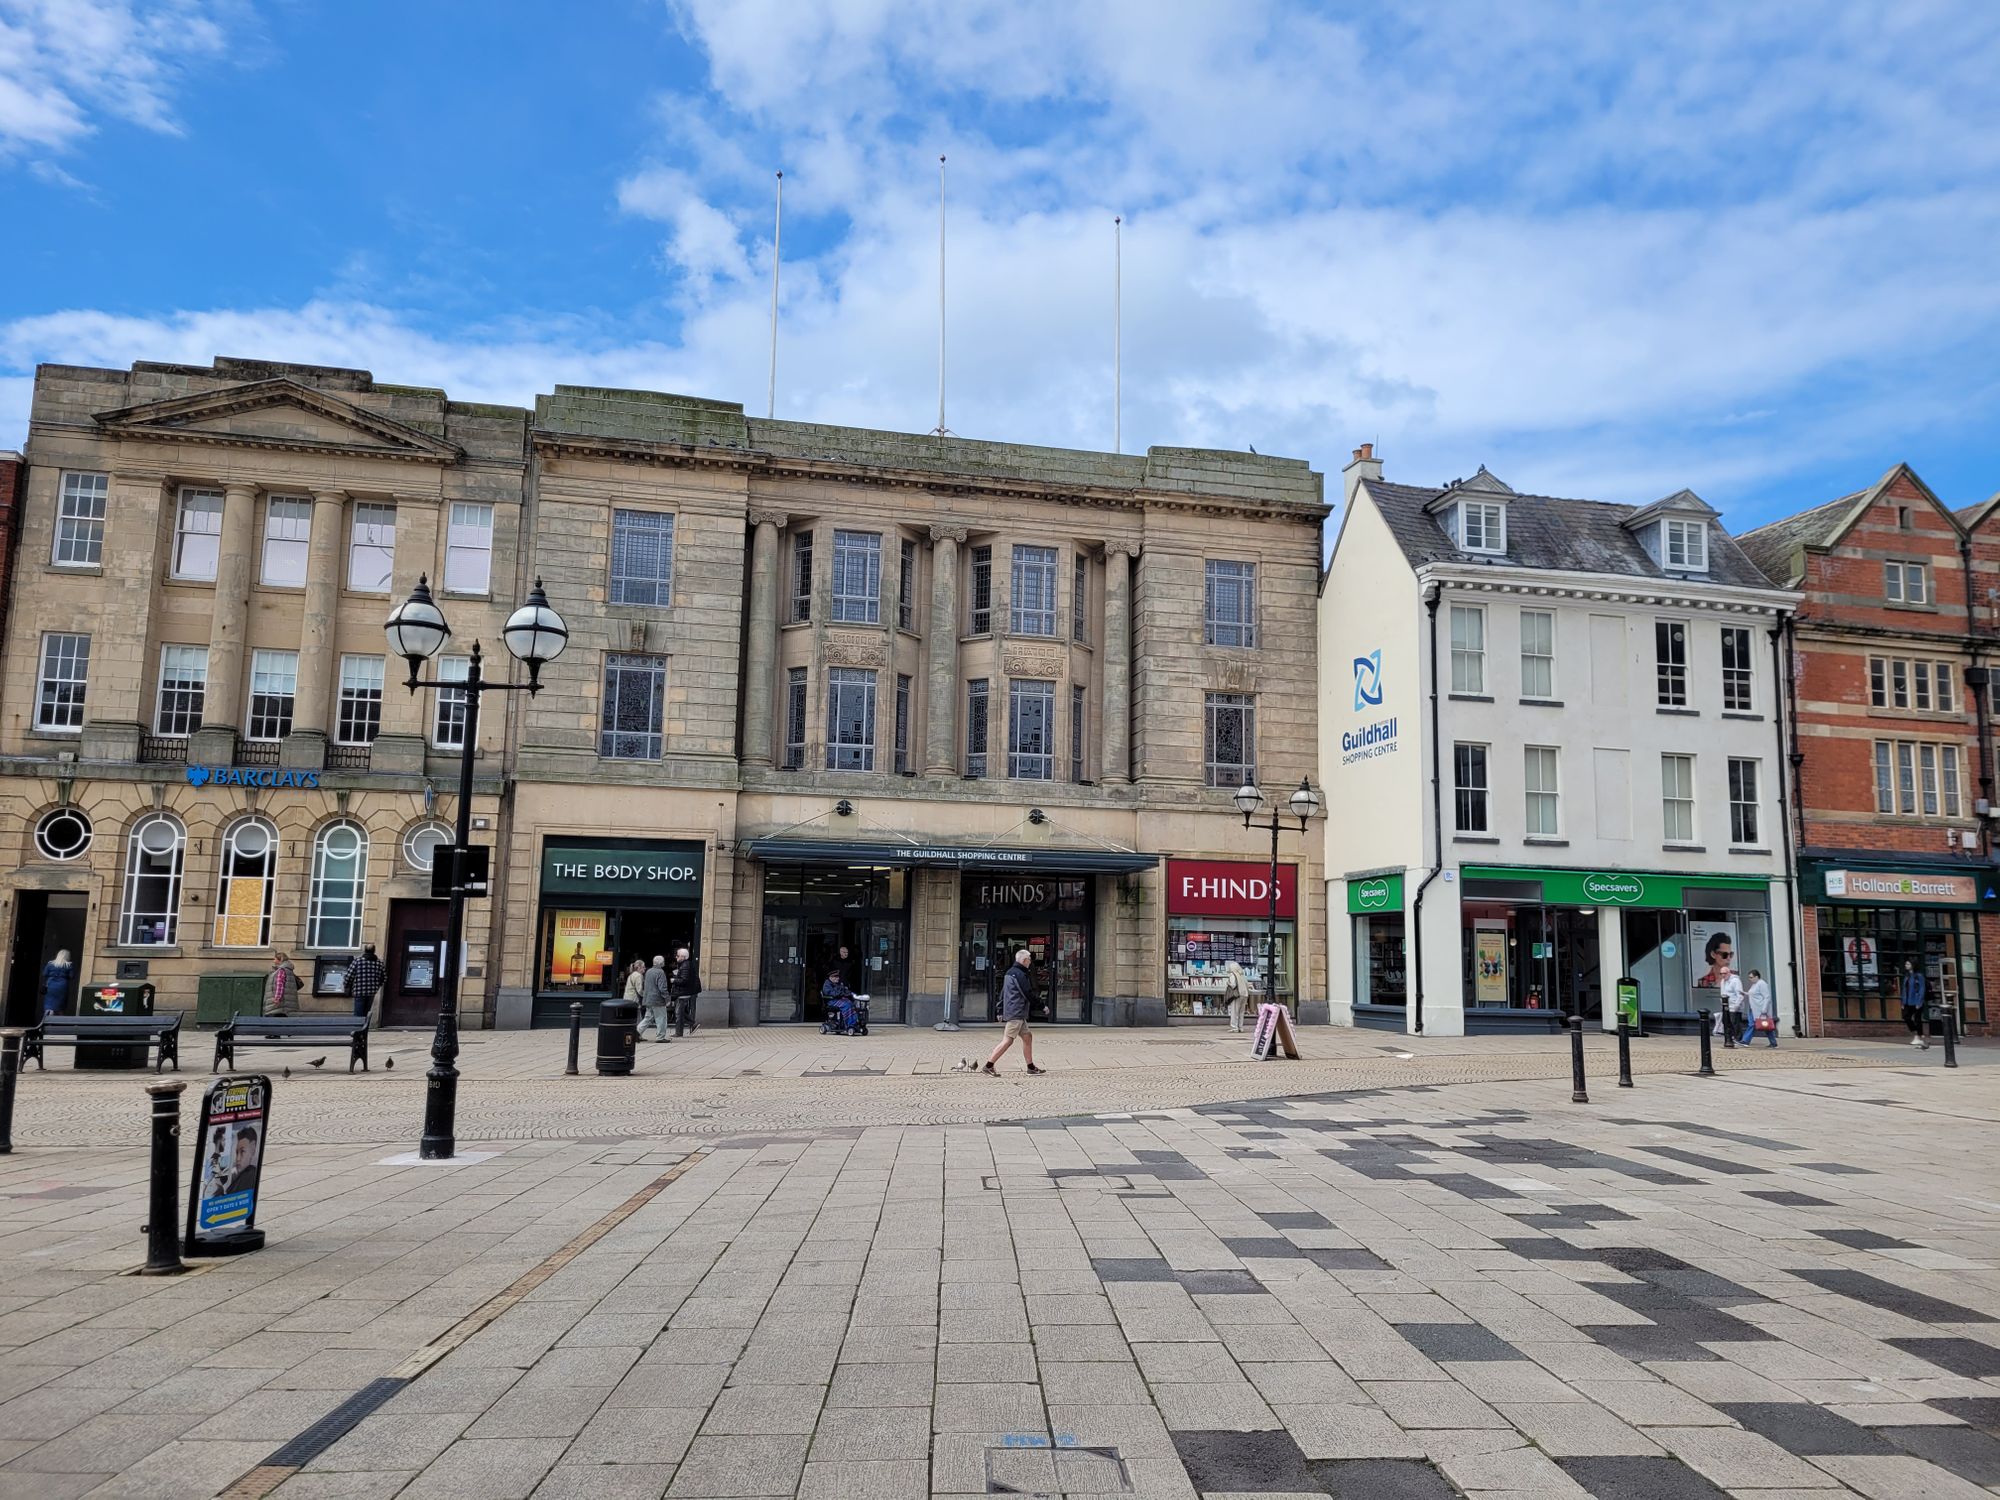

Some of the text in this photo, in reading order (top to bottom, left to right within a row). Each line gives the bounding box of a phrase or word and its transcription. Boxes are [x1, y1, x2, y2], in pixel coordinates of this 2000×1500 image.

[1342, 717, 1397, 752] Guildhall
[1342, 741, 1398, 766] SHOPPING CENTRE
[214, 767, 320, 788] BARCLAYS
[896, 850, 1027, 861] THE GUILDHALL SHOPPING CENTRE
[553, 863, 588, 878] THE
[594, 864, 644, 880] BODY
[981, 884, 1044, 904] F.HINDS
[1183, 877, 1281, 900] F.HINDS
[1361, 888, 1386, 898] Specsavers
[1589, 882, 1638, 892] Specsavers
[1852, 878, 1901, 893] Holland
[1911, 880, 1957, 895] Barrett
